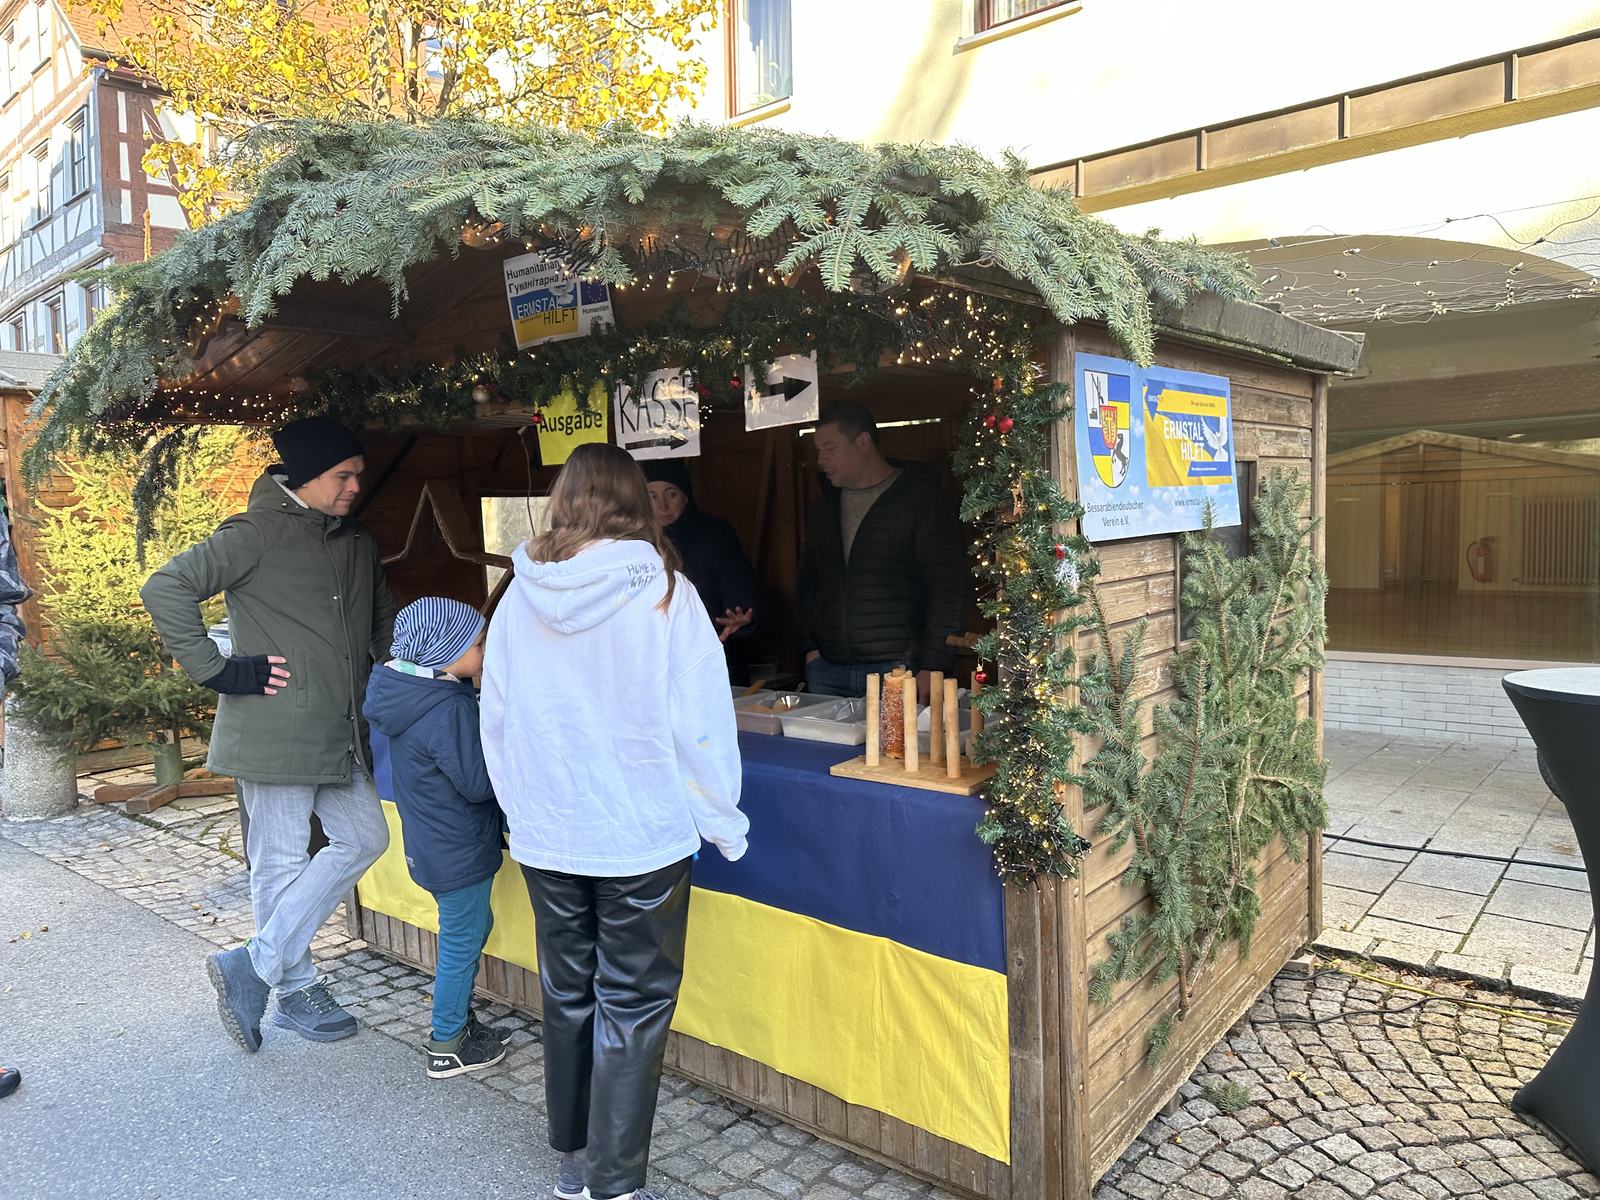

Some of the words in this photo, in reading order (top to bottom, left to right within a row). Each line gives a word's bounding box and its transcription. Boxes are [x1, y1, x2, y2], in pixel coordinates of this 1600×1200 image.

[506, 259, 560, 280] Humanitarian
[508, 273, 559, 294] Гуманітарна
[516, 295, 562, 319] ERMSTAL
[543, 308, 577, 326] HILFT
[617, 374, 697, 434] KASSE
[539, 413, 603, 436] Ausgabe
[1163, 420, 1204, 441] ERMSTAL
[1181, 442, 1204, 461] HILFT
[1086, 500, 1144, 513] Bessarabiendeutscher
[1102, 516, 1120, 527] Verein
[433, 1059, 450, 1067] FILA
